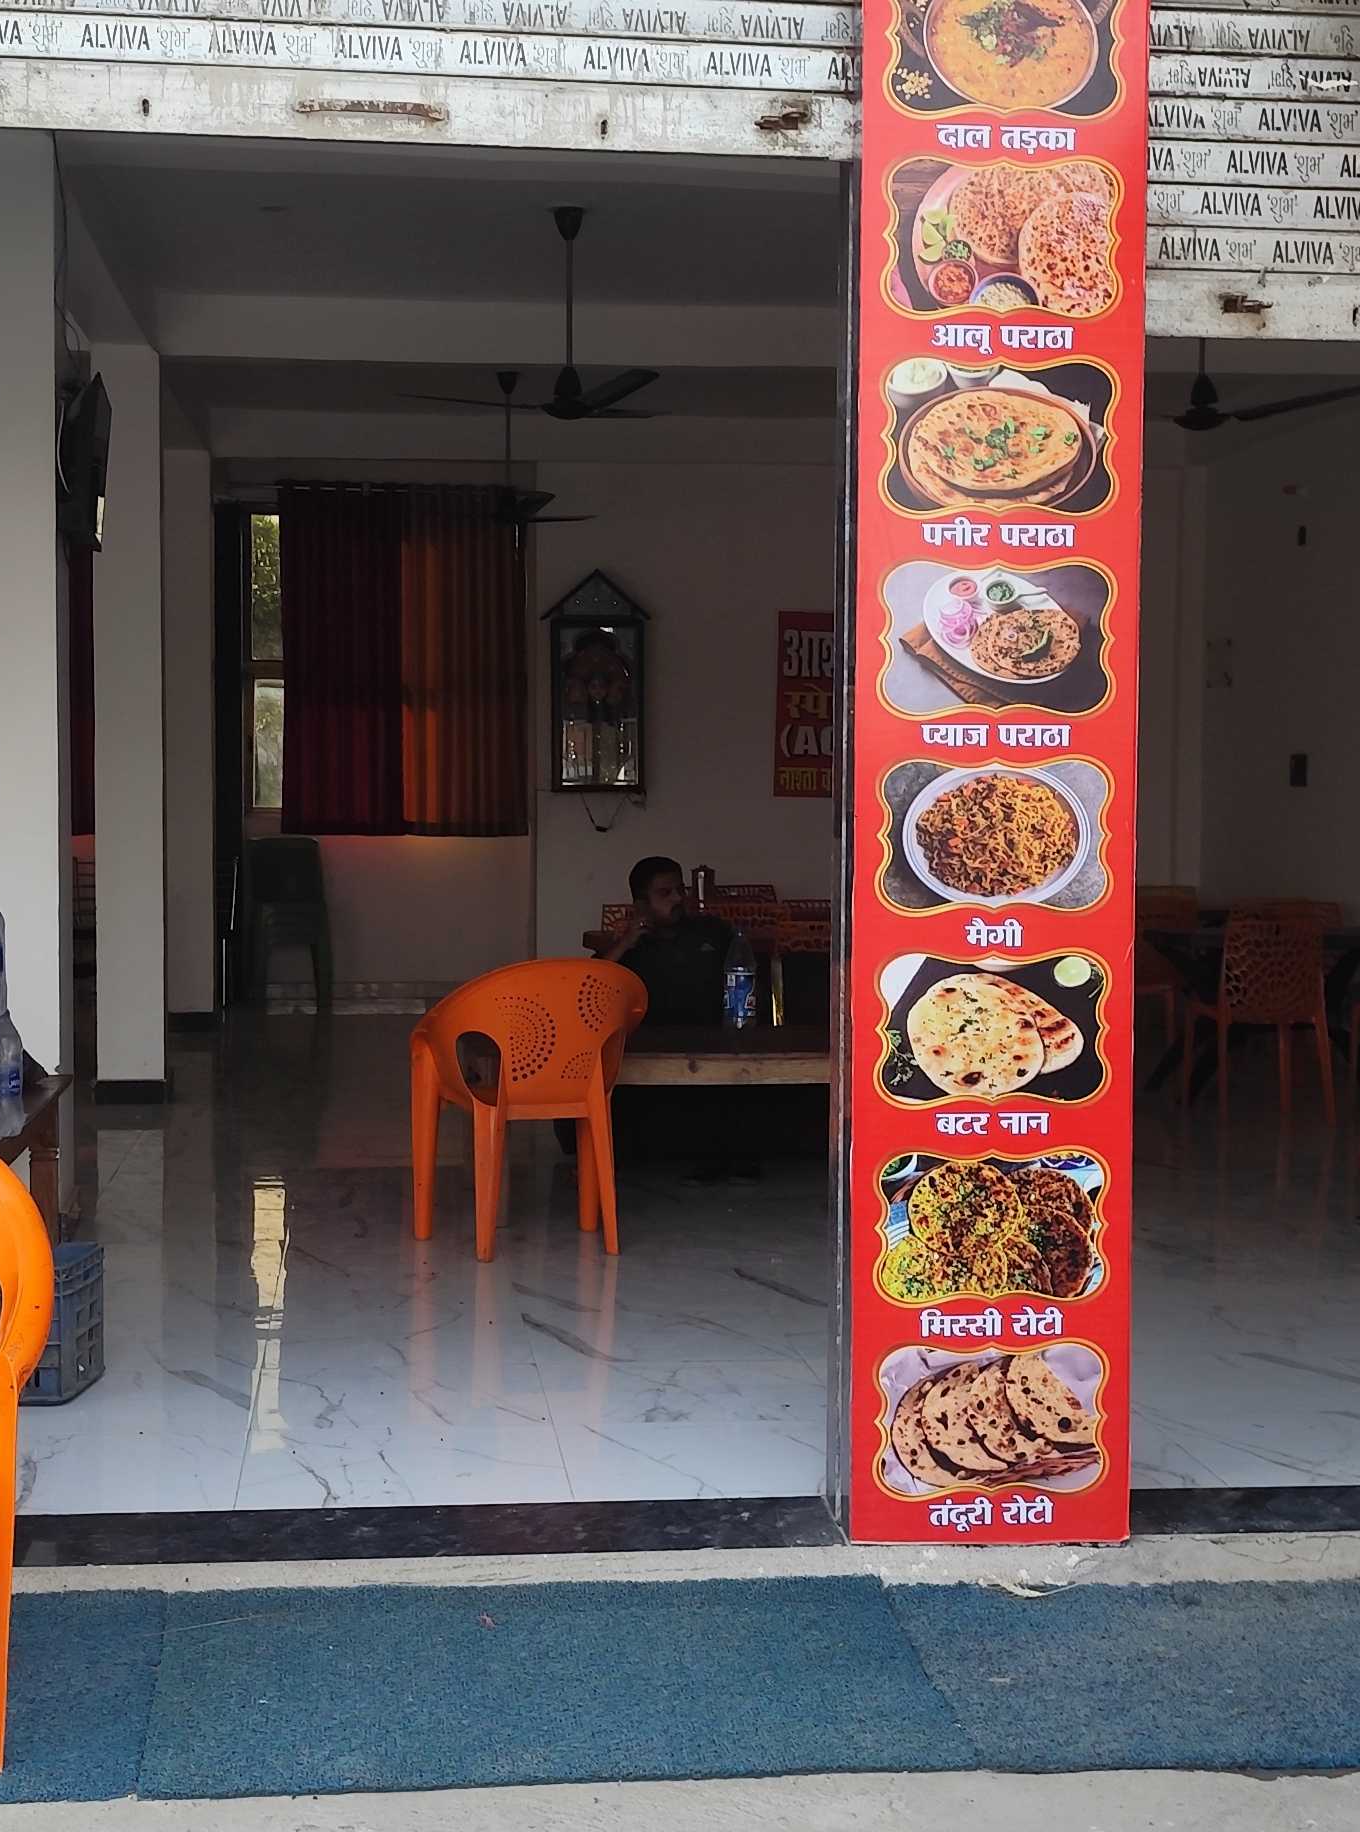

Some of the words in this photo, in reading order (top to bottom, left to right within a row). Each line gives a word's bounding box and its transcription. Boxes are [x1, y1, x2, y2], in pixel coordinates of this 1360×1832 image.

[81, 24, 150, 51] ALVIVA
[460, 39, 527, 67] ALVIVA
[706, 53, 772, 78] ALVIVA
[1259, 108, 1321, 132] ALVIVA
[937, 122, 991, 150] दाल
[1001, 125, 1075, 155] तड़का
[1227, 150, 1288, 175] ALVIVA
[1200, 191, 1261, 216] ALVIVA
[1158, 236, 1220, 261] ALVIVA
[1272, 240, 1334, 265] ALVIVA
[932, 322, 993, 353] आलू
[1000, 325, 1074, 349] पराठा
[922, 518, 991, 547] पनीर
[1000, 524, 1075, 547] पराठा
[921, 723, 988, 747] प्याज
[999, 723, 1071, 747] पराठा
[965, 916, 1023, 947] मैगी
[935, 1111, 990, 1135] बटर
[998, 1111, 1049, 1134] नान
[921, 1306, 1002, 1337] मिस्सी
[1012, 1305, 1063, 1336] रोटी
[928, 1496, 991, 1531] तंदूरी
[1003, 1495, 1053, 1525] रोटी
